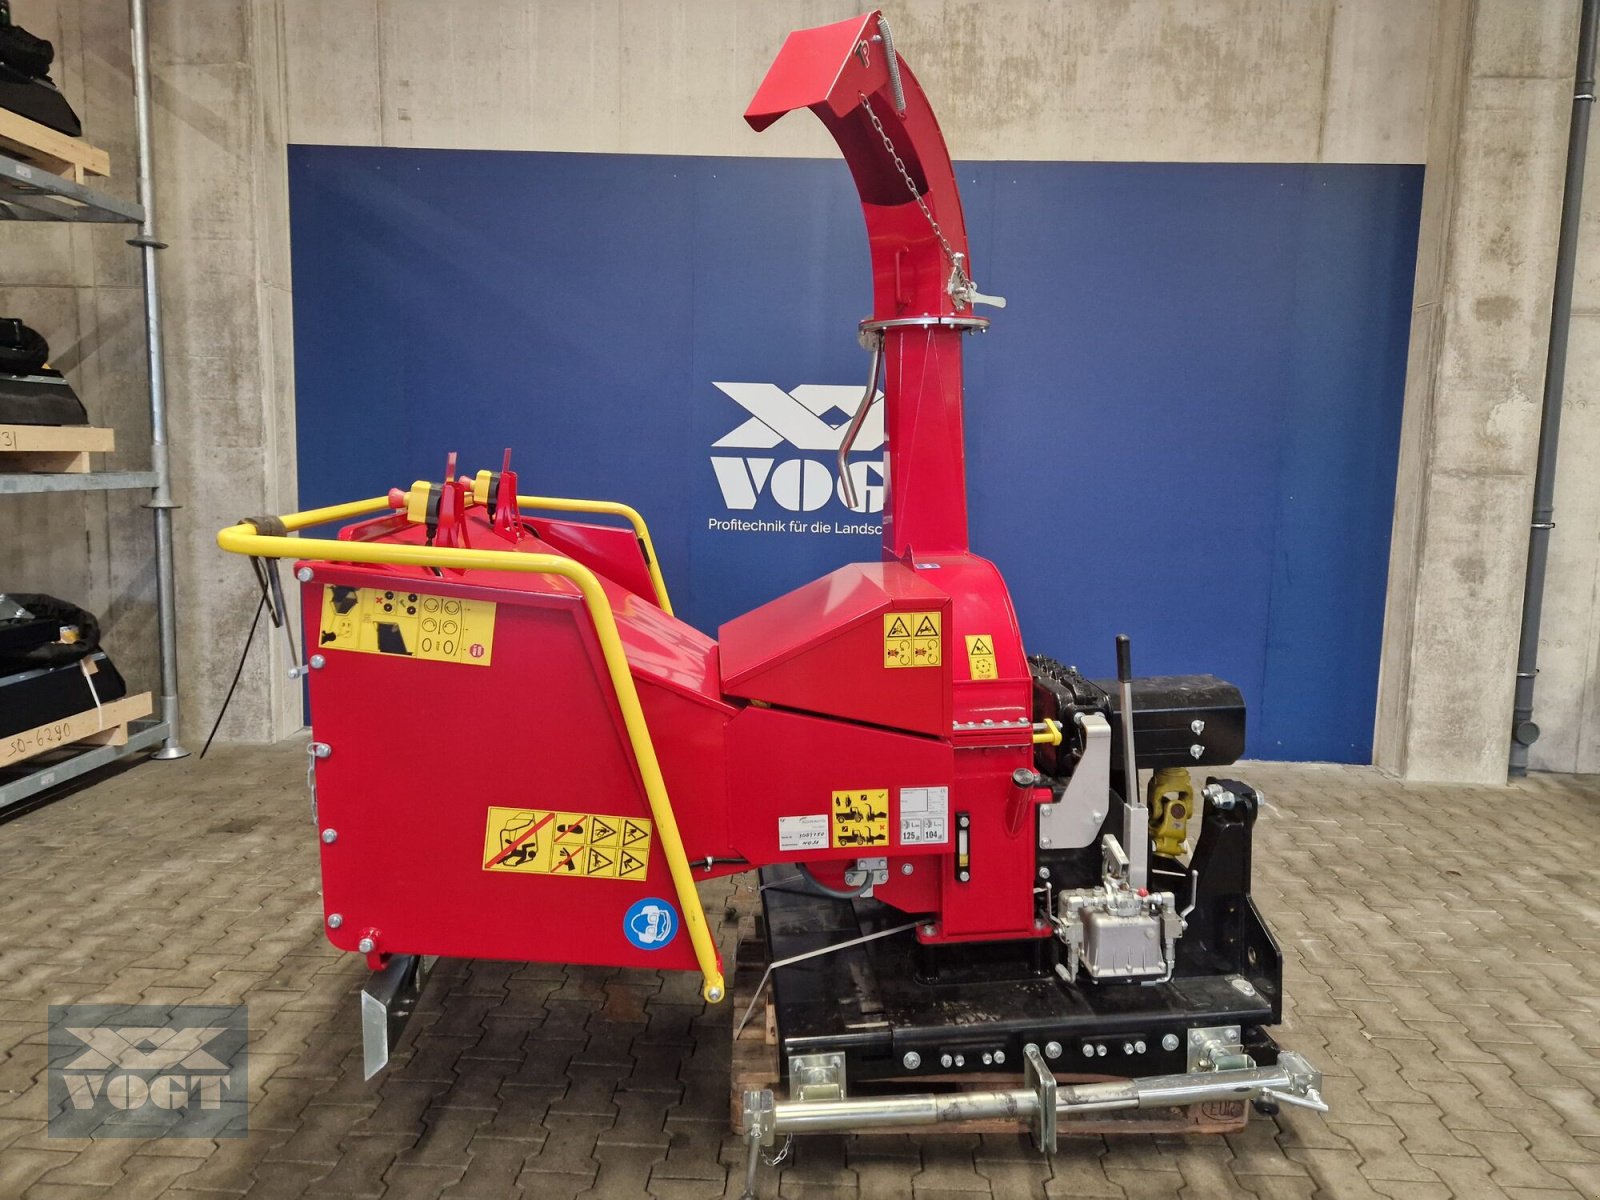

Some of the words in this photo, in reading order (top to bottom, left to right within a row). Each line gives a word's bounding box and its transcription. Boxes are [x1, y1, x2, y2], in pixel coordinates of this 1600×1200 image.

[708, 518, 786, 532] Profitechnik
[789, 520, 808, 533] für
[810, 521, 831, 534] die
[834, 522, 883, 536] Landsc
[903, 832, 916, 840] 125
[925, 830, 938, 839] 104
